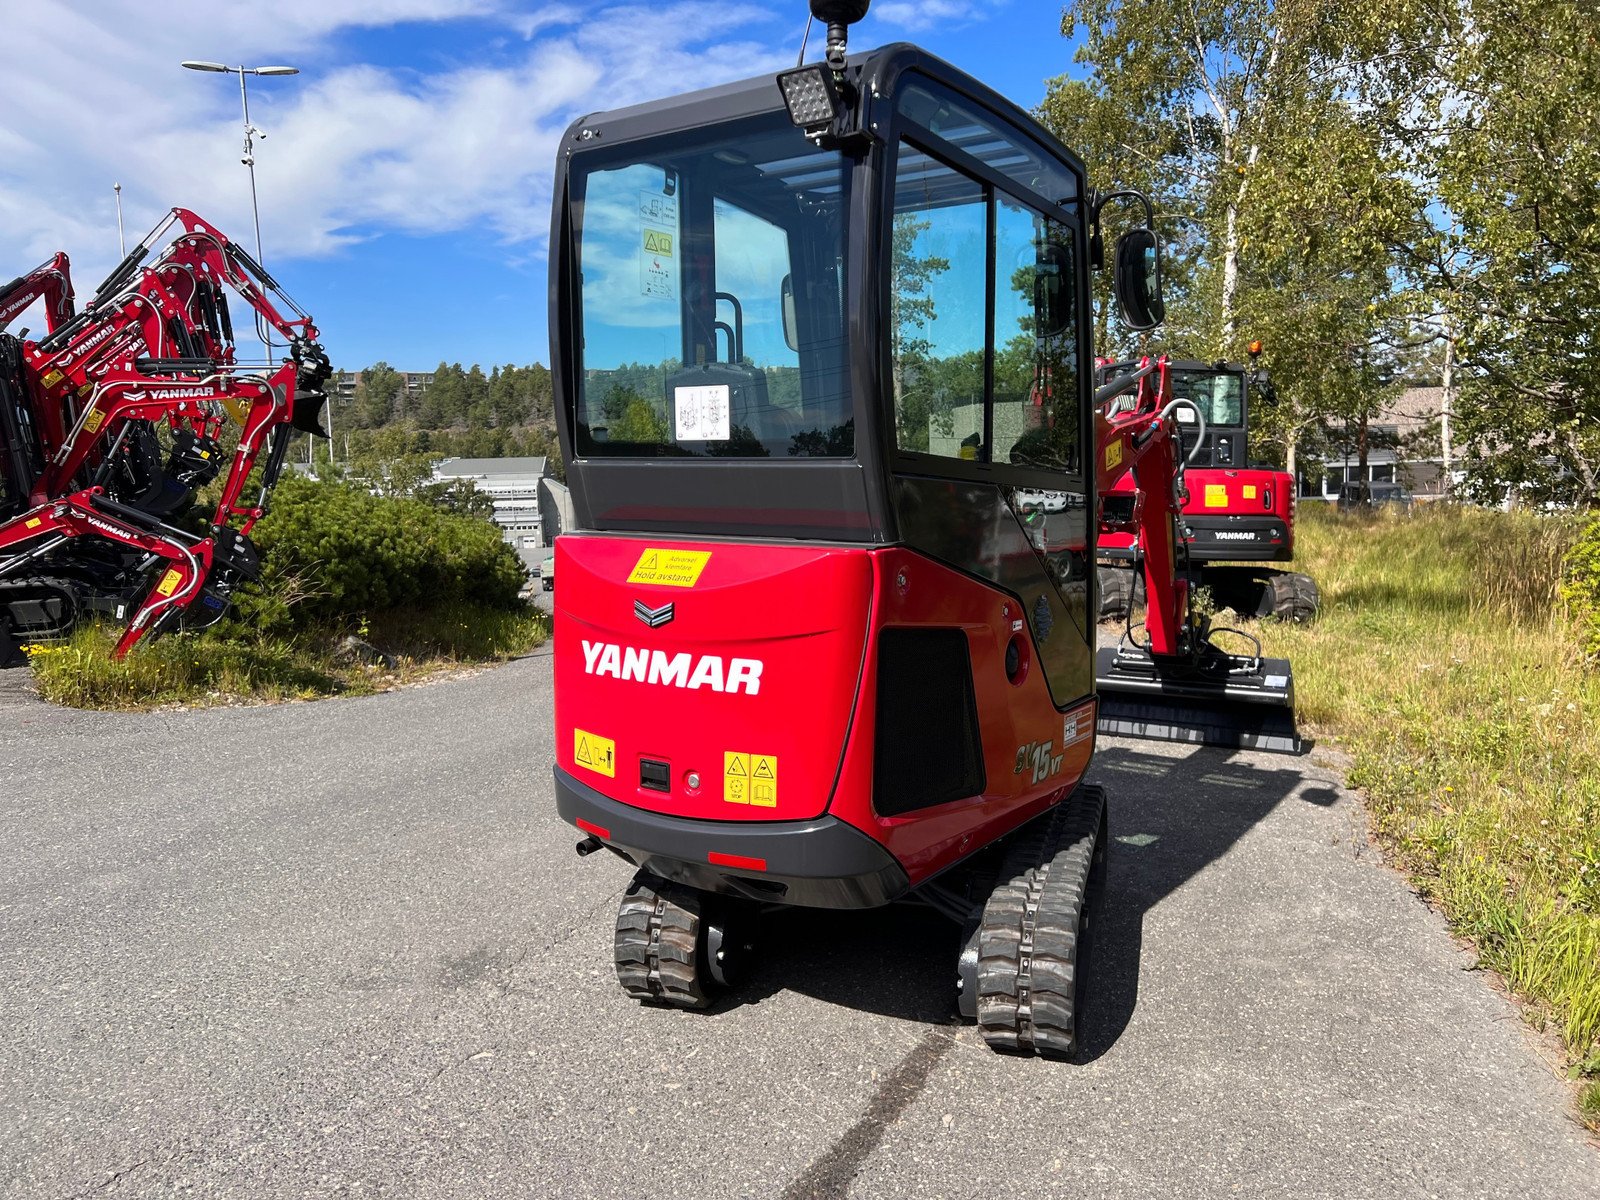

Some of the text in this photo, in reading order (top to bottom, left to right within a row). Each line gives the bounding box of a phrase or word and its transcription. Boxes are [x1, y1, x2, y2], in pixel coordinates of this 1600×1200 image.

[7, 293, 34, 312] YANMAR
[73, 325, 115, 356] YANMAR
[149, 386, 215, 400] YANMAR
[88, 516, 131, 539] YANMAR
[1215, 532, 1255, 540] YANMAR
[634, 570, 693, 583] Hold avstand
[581, 639, 764, 696] YANMAR
